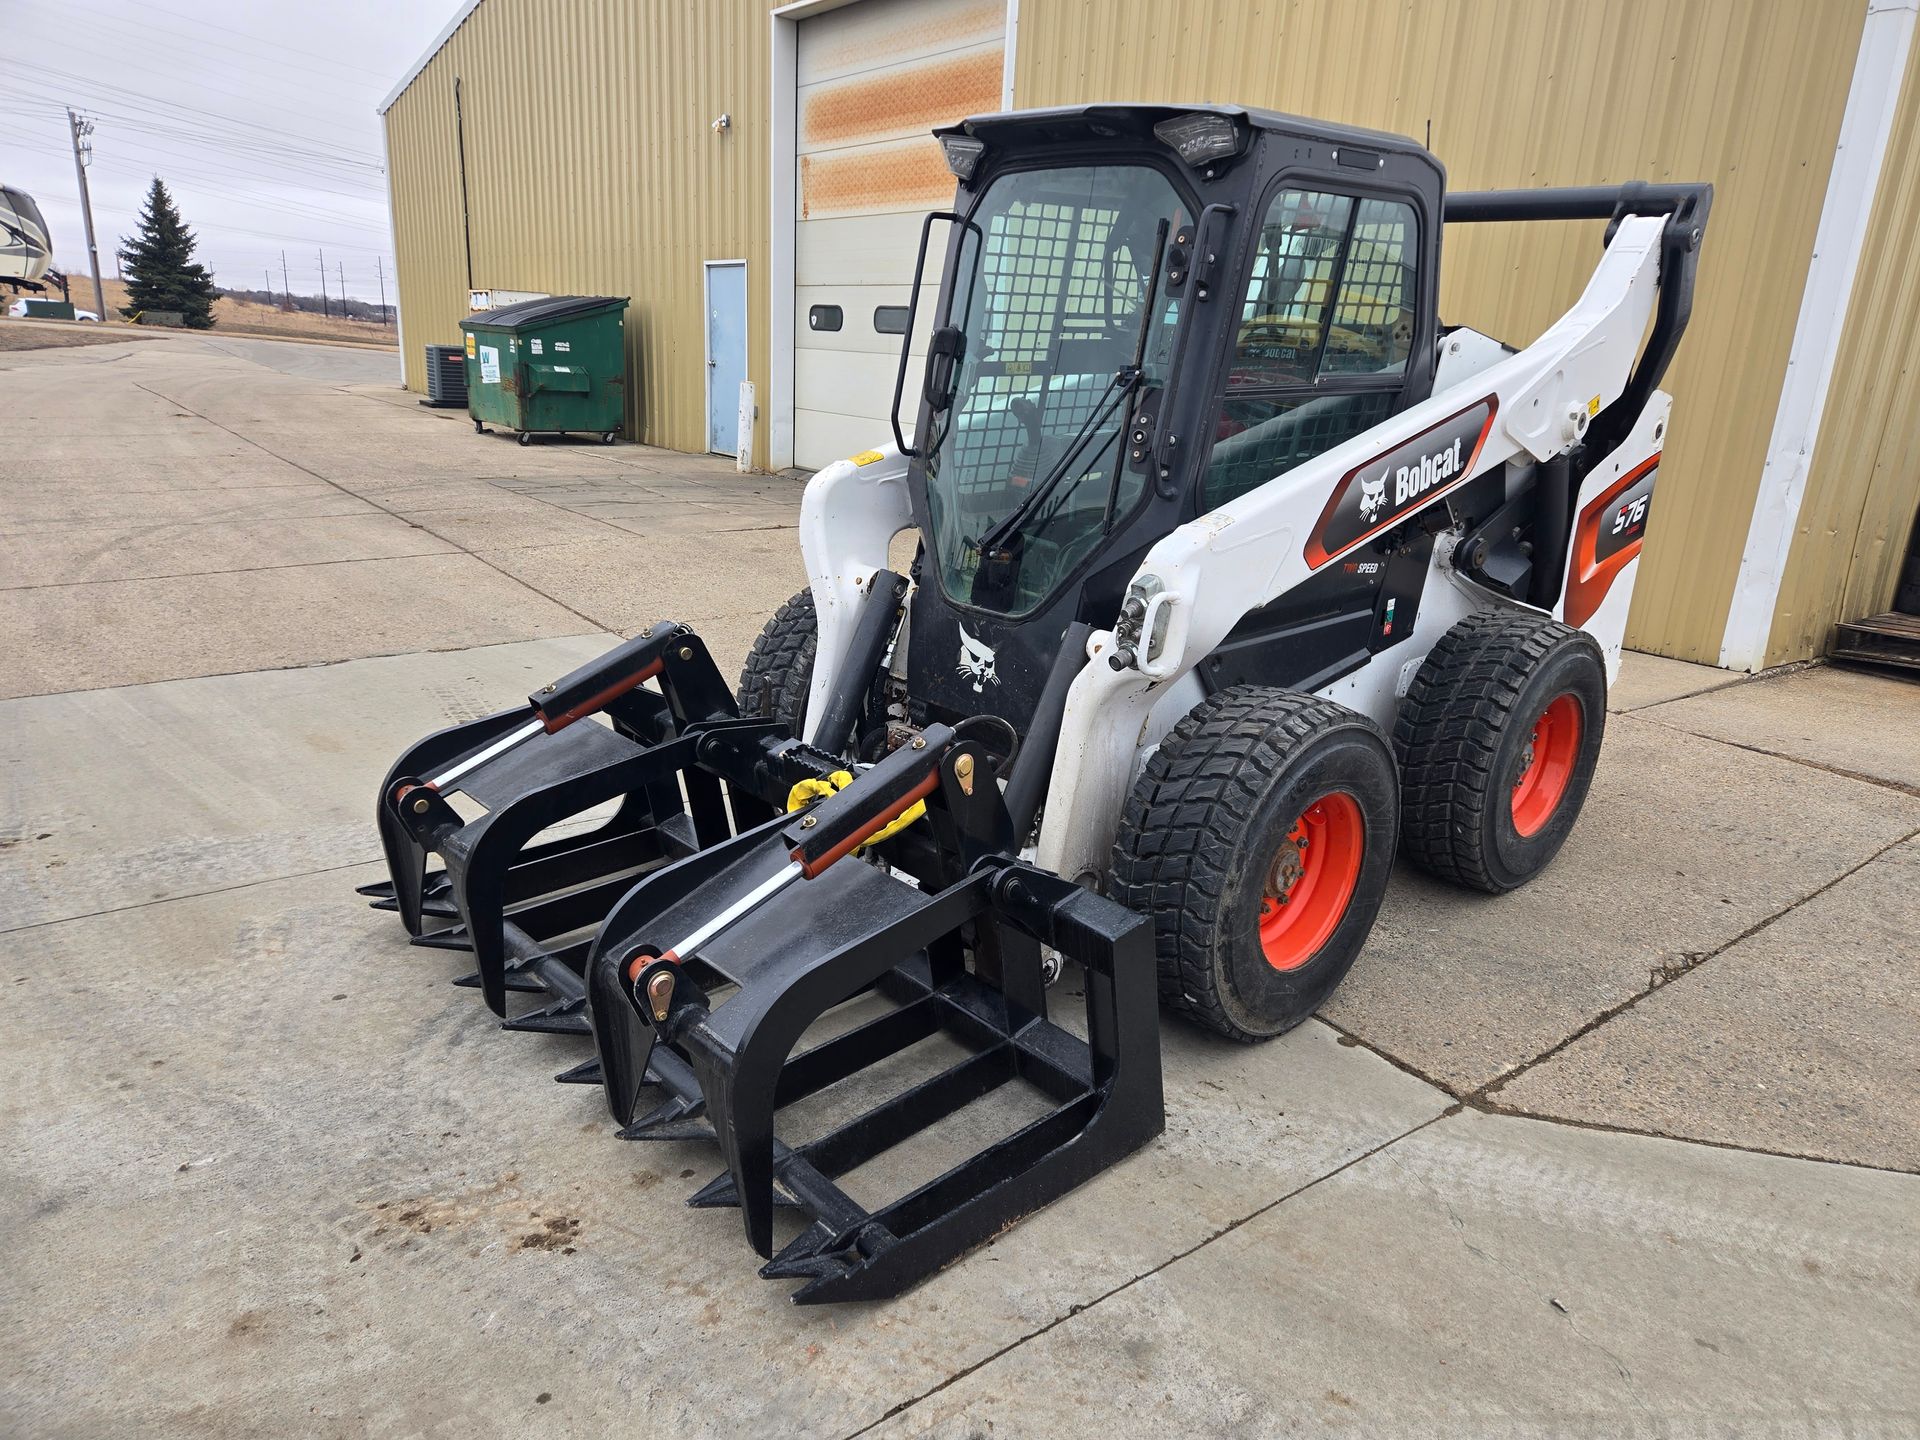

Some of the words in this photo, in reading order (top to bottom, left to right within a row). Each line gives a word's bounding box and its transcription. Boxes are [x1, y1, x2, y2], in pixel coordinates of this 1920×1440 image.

[1395, 437, 1462, 507] Bobcat
[1612, 494, 1649, 535] S76
[1357, 562, 1379, 574] SPEED
